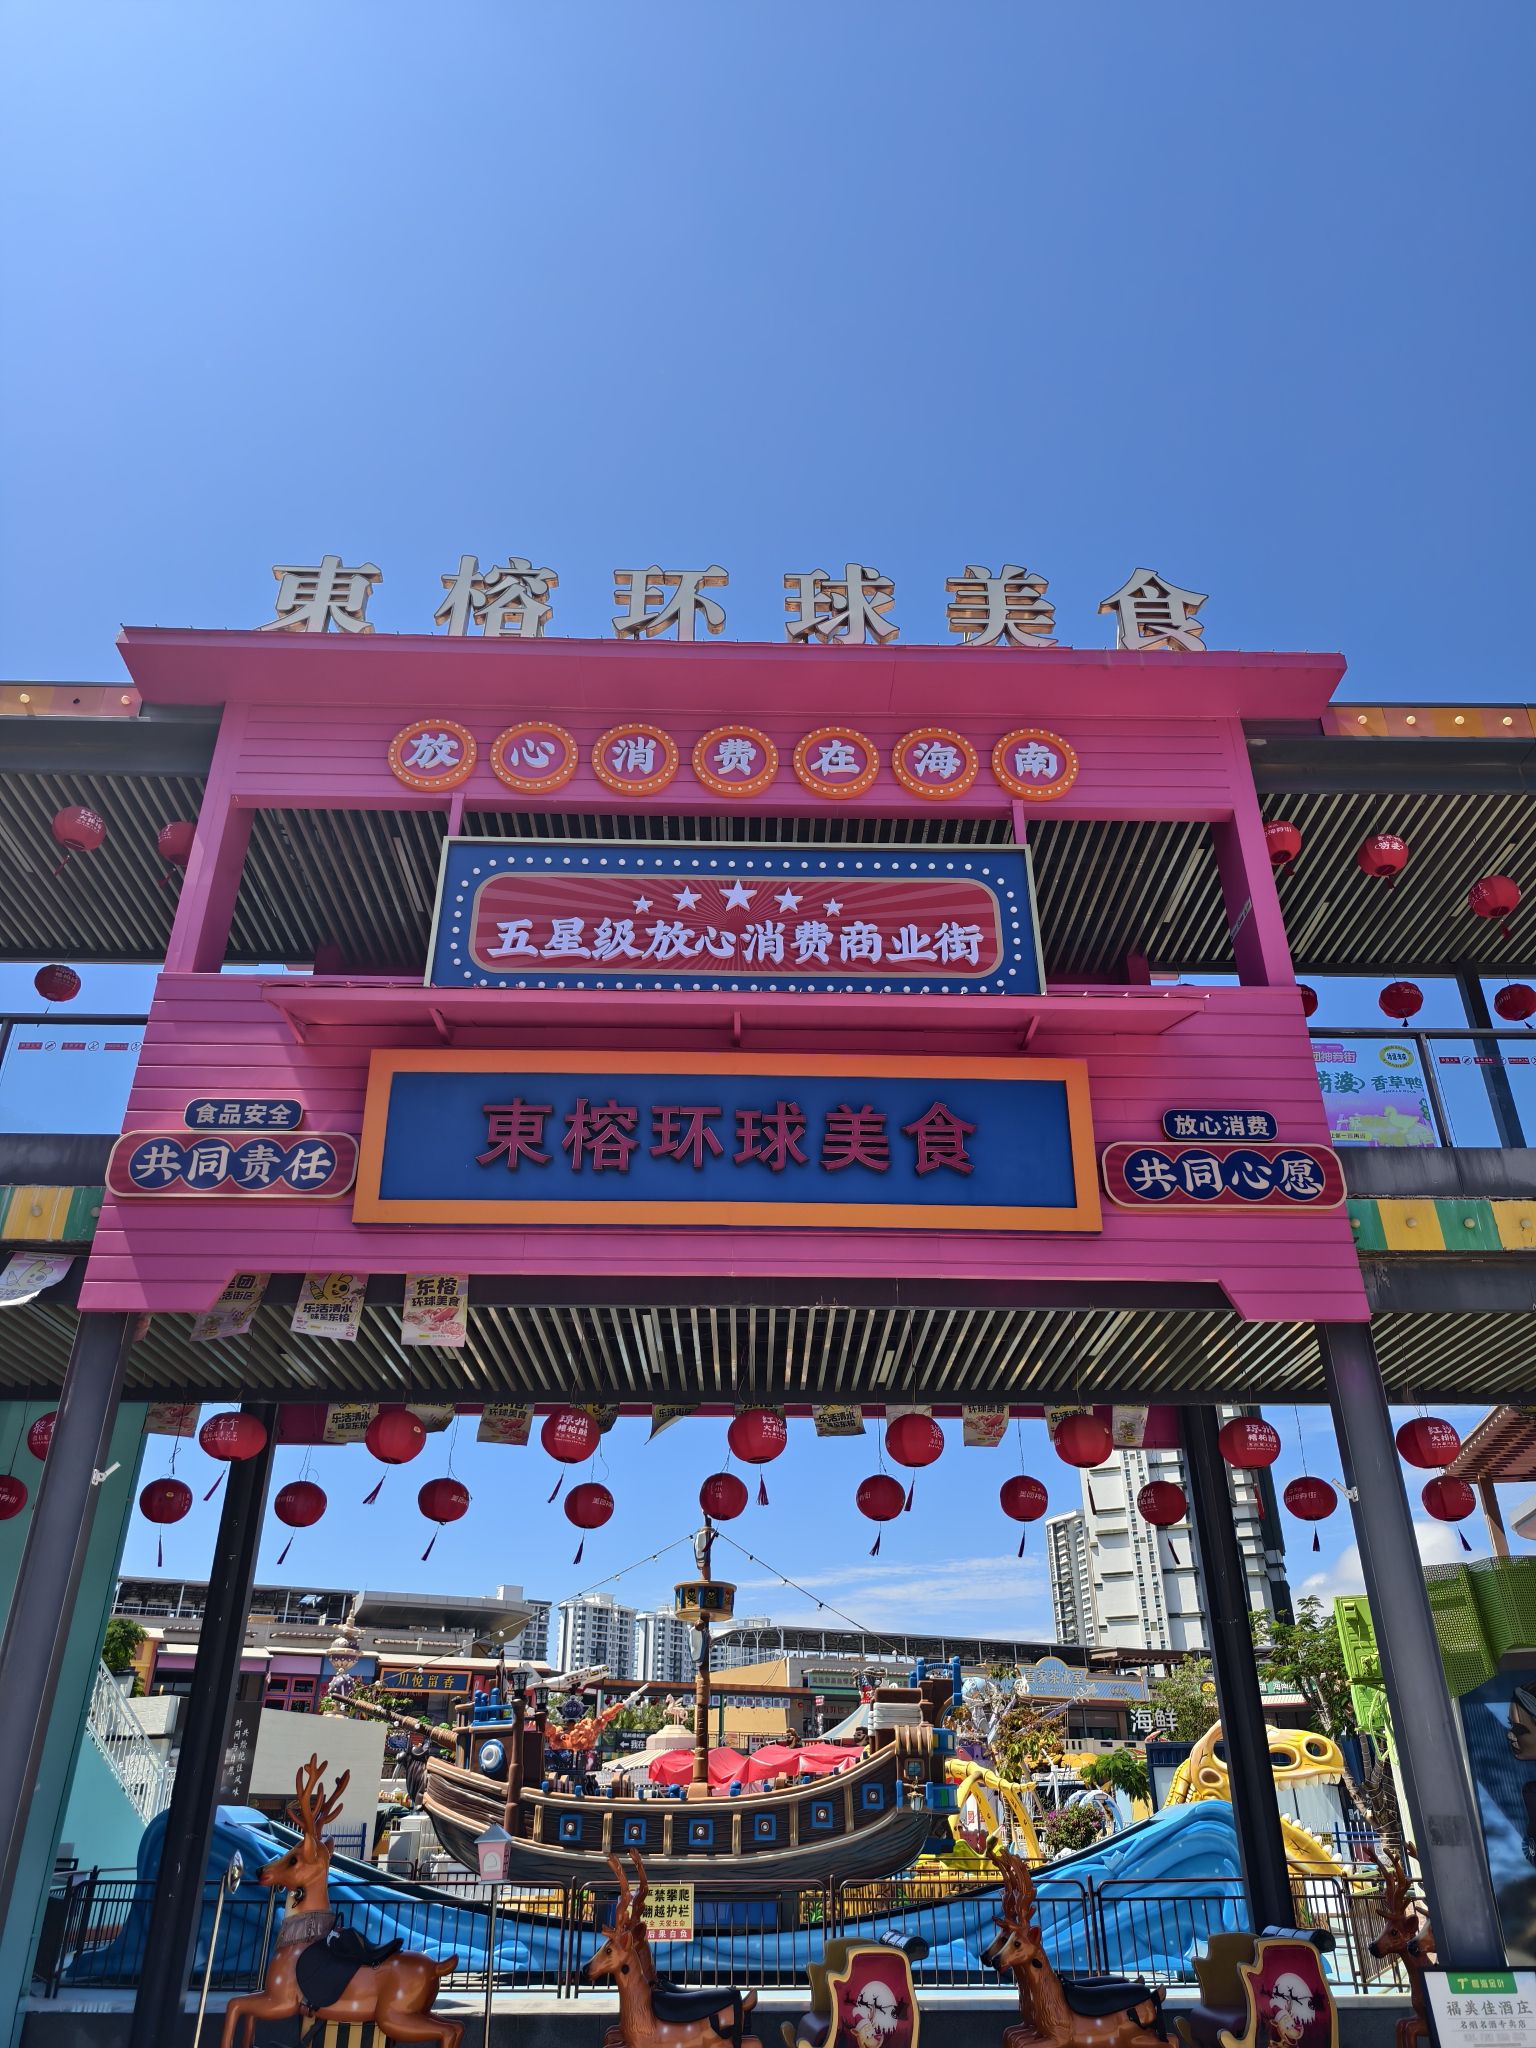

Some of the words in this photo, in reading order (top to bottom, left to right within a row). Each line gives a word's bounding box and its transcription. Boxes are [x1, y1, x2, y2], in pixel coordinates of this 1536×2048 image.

[257, 554, 1209, 651] 東榕环球美食
[410, 732, 1060, 779] 放心消费在海南
[487, 915, 985, 966] 五星级放心消费商业街
[196, 1102, 292, 1126] 食品安全
[1173, 1113, 1271, 1137] 放心消费
[475, 1097, 978, 1177] 東榕环球美食
[133, 1143, 333, 1184] 共同责任
[1131, 1156, 1325, 1194] 共同心愿
[416, 1277, 458, 1296] 东榕
[411, 1295, 461, 1307] 环球美食
[1130, 1707, 1180, 1734] 海鲜
[642, 1904, 690, 1918] 翻越护栏
[647, 1929, 688, 1940] 后果自负
[659, 1919, 686, 1928] 关爱生命
[1446, 1999, 1533, 2016] 福美佳酒庄
